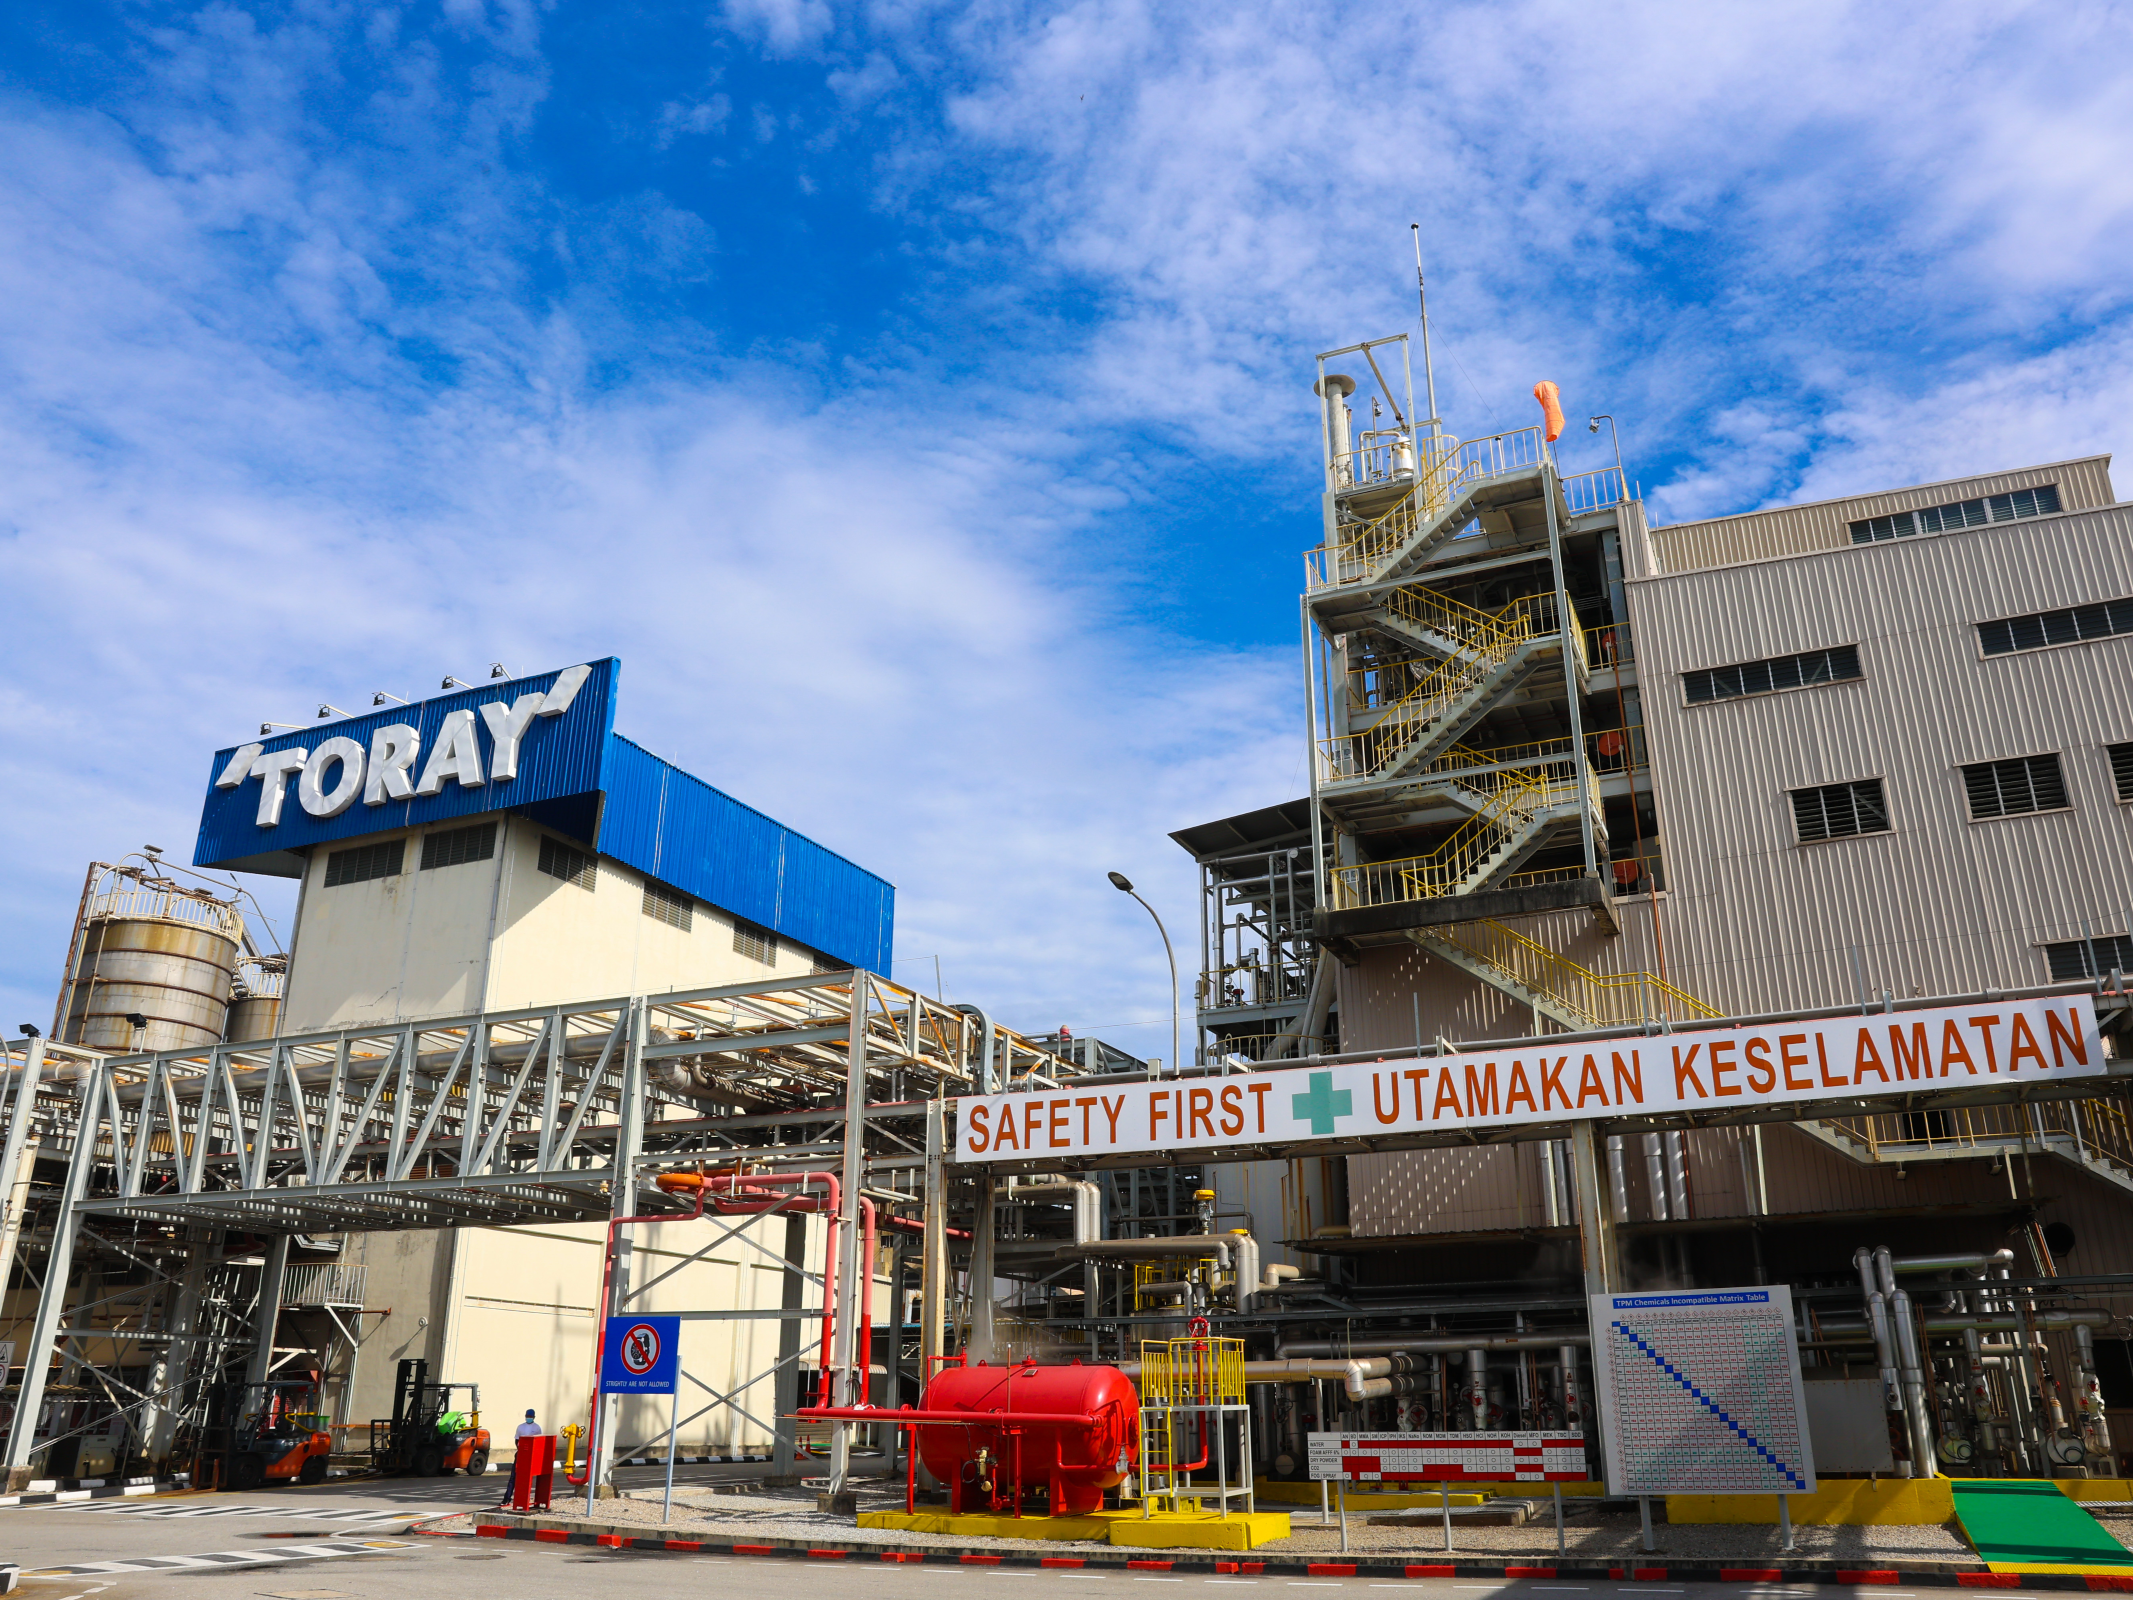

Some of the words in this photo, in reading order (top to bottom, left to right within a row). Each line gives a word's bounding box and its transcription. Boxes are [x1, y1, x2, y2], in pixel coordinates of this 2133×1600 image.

[215, 664, 591, 828] TORAY
[968, 1094, 1126, 1154] SAFETY
[1149, 1082, 1273, 1142] FIRST
[1372, 1049, 1645, 1125] UTAMAKAN
[1671, 1007, 2089, 1101] KESELAMATAN
[1634, 1298, 1670, 1306] Chemicals
[1671, 1296, 1718, 1305] Incompatible
[1719, 1294, 1744, 1302] Matrix
